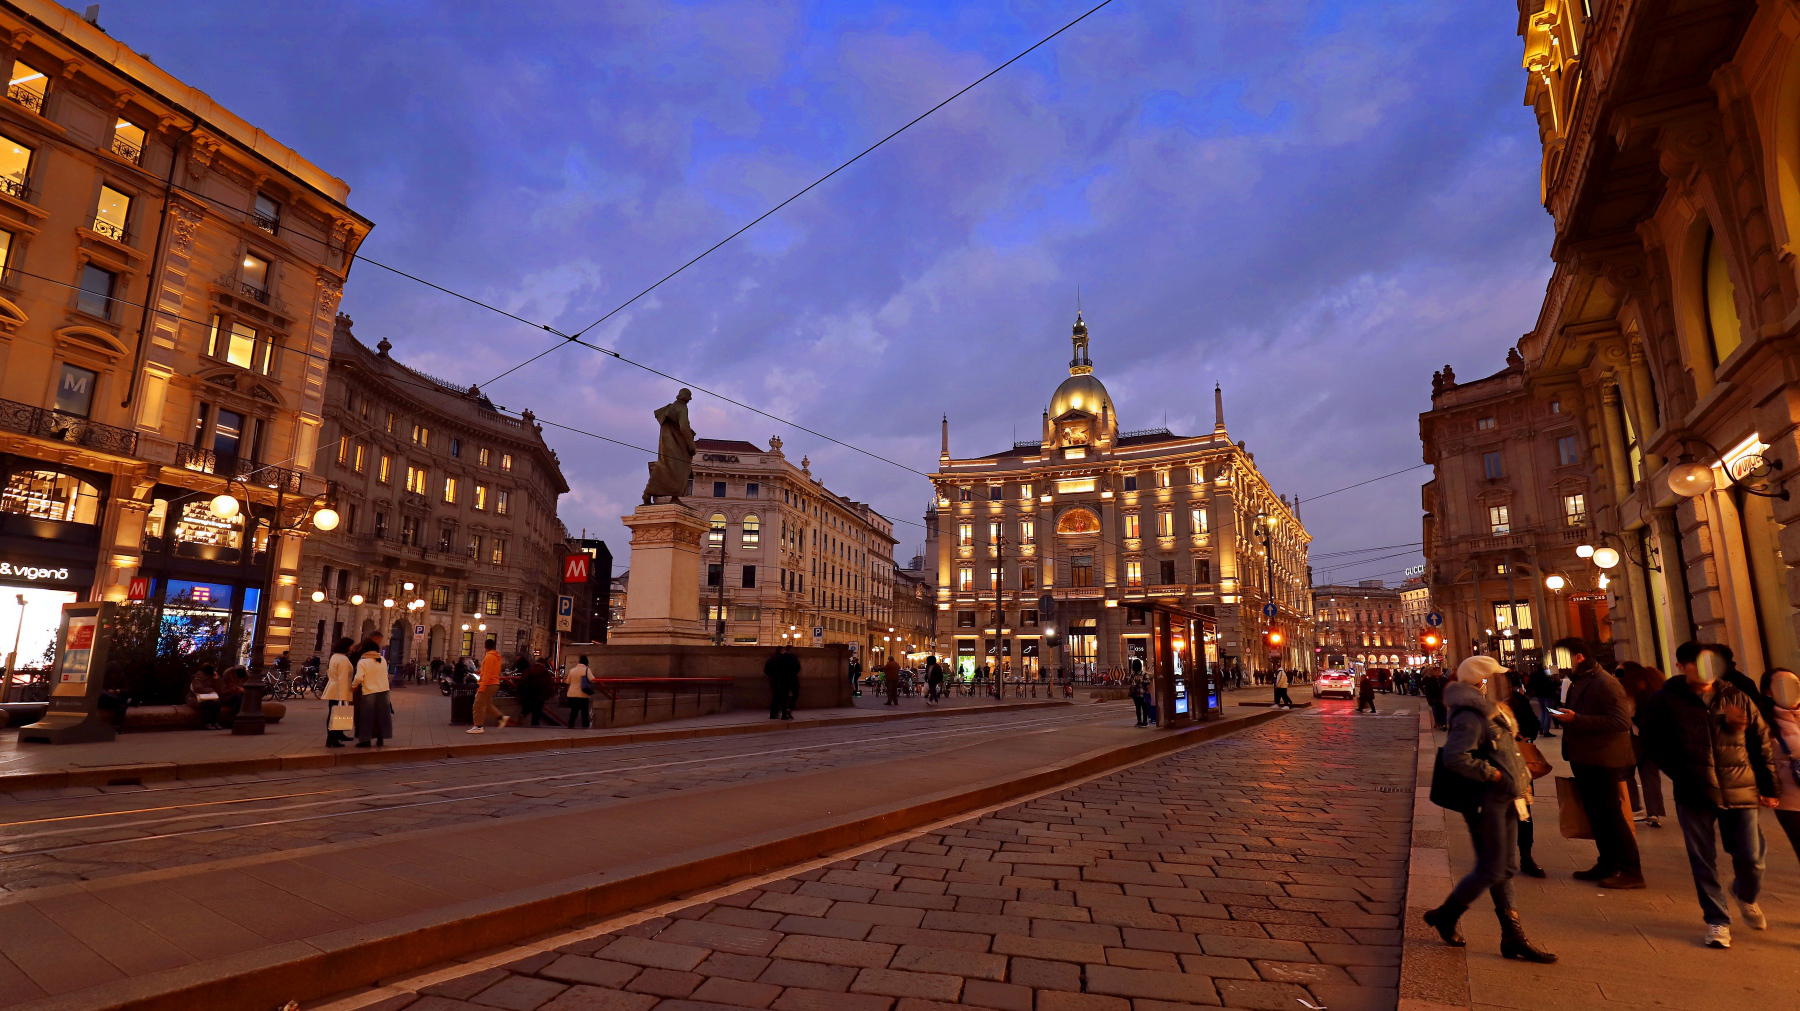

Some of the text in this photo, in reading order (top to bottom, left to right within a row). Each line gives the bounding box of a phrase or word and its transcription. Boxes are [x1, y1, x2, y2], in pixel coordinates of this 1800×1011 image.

[64, 373, 87, 393] M
[0, 562, 12, 575] &
[566, 560, 586, 577] M
[1405, 564, 1425, 576] GUCCI
[129, 582, 144, 596] M
[561, 599, 570, 614] P
